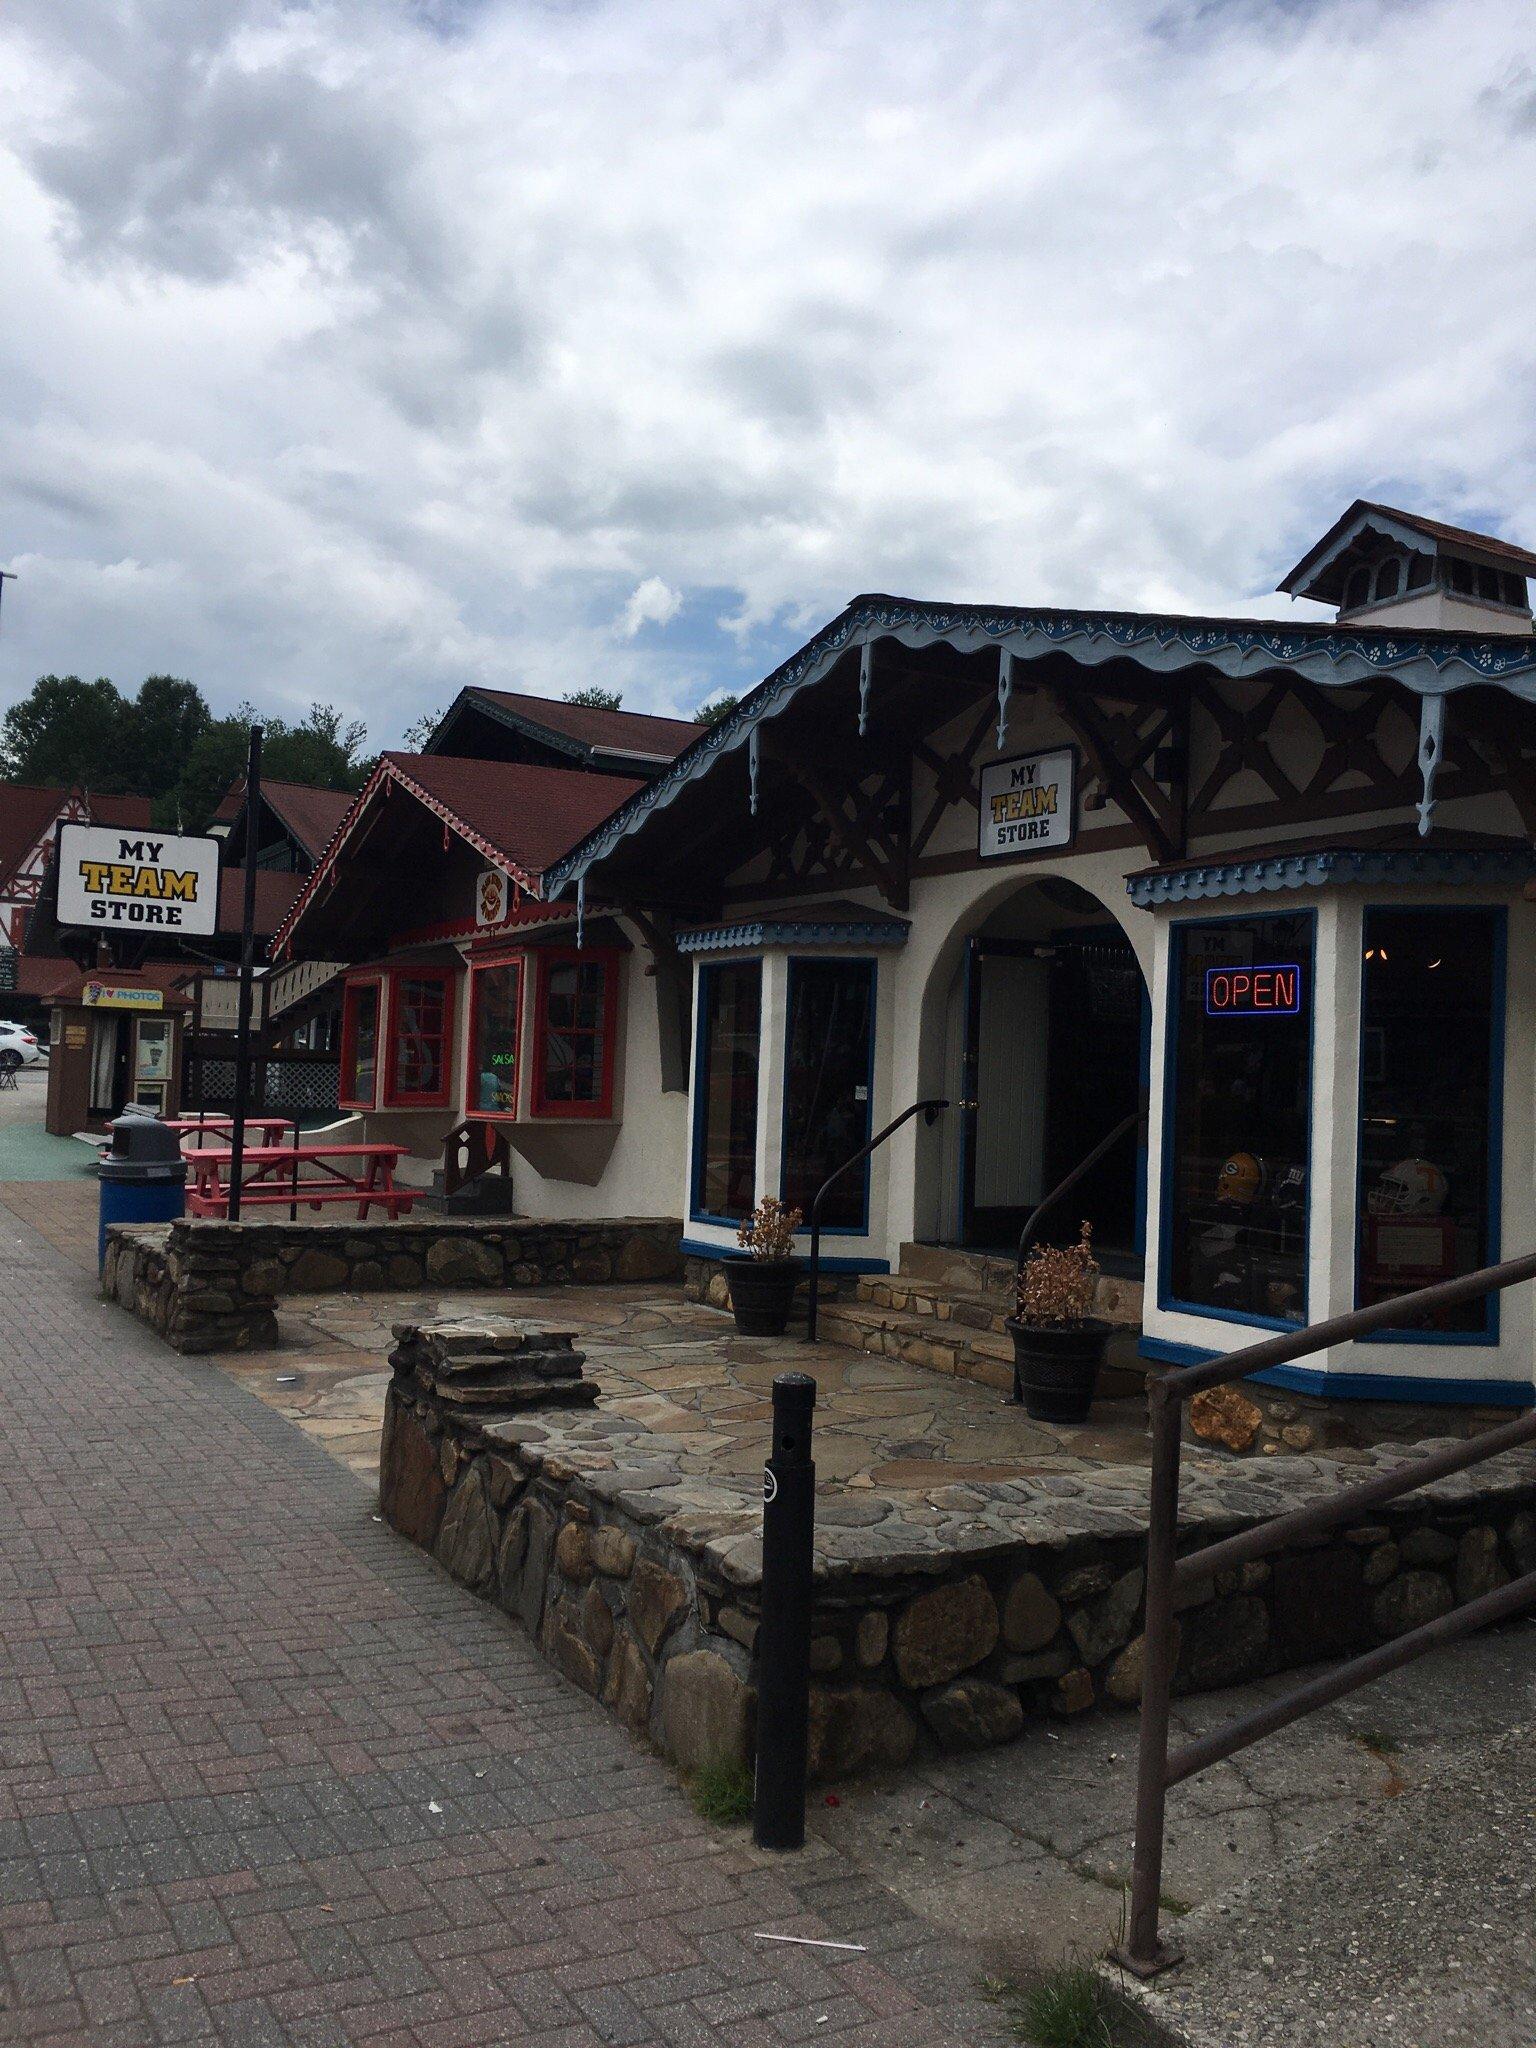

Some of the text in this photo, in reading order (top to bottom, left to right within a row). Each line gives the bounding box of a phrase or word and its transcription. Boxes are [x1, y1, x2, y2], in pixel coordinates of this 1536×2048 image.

[1010, 764, 1036, 787] MY
[991, 783, 1058, 824] TEAM
[998, 819, 1050, 845] STORE
[118, 839, 163, 862] MY
[79, 860, 198, 902] TEAM
[91, 900, 182, 925] STORE
[117, 991, 160, 1001] PHOTOS
[1213, 973, 1294, 1007] OPEN
[491, 1054, 515, 1065] SALSA
